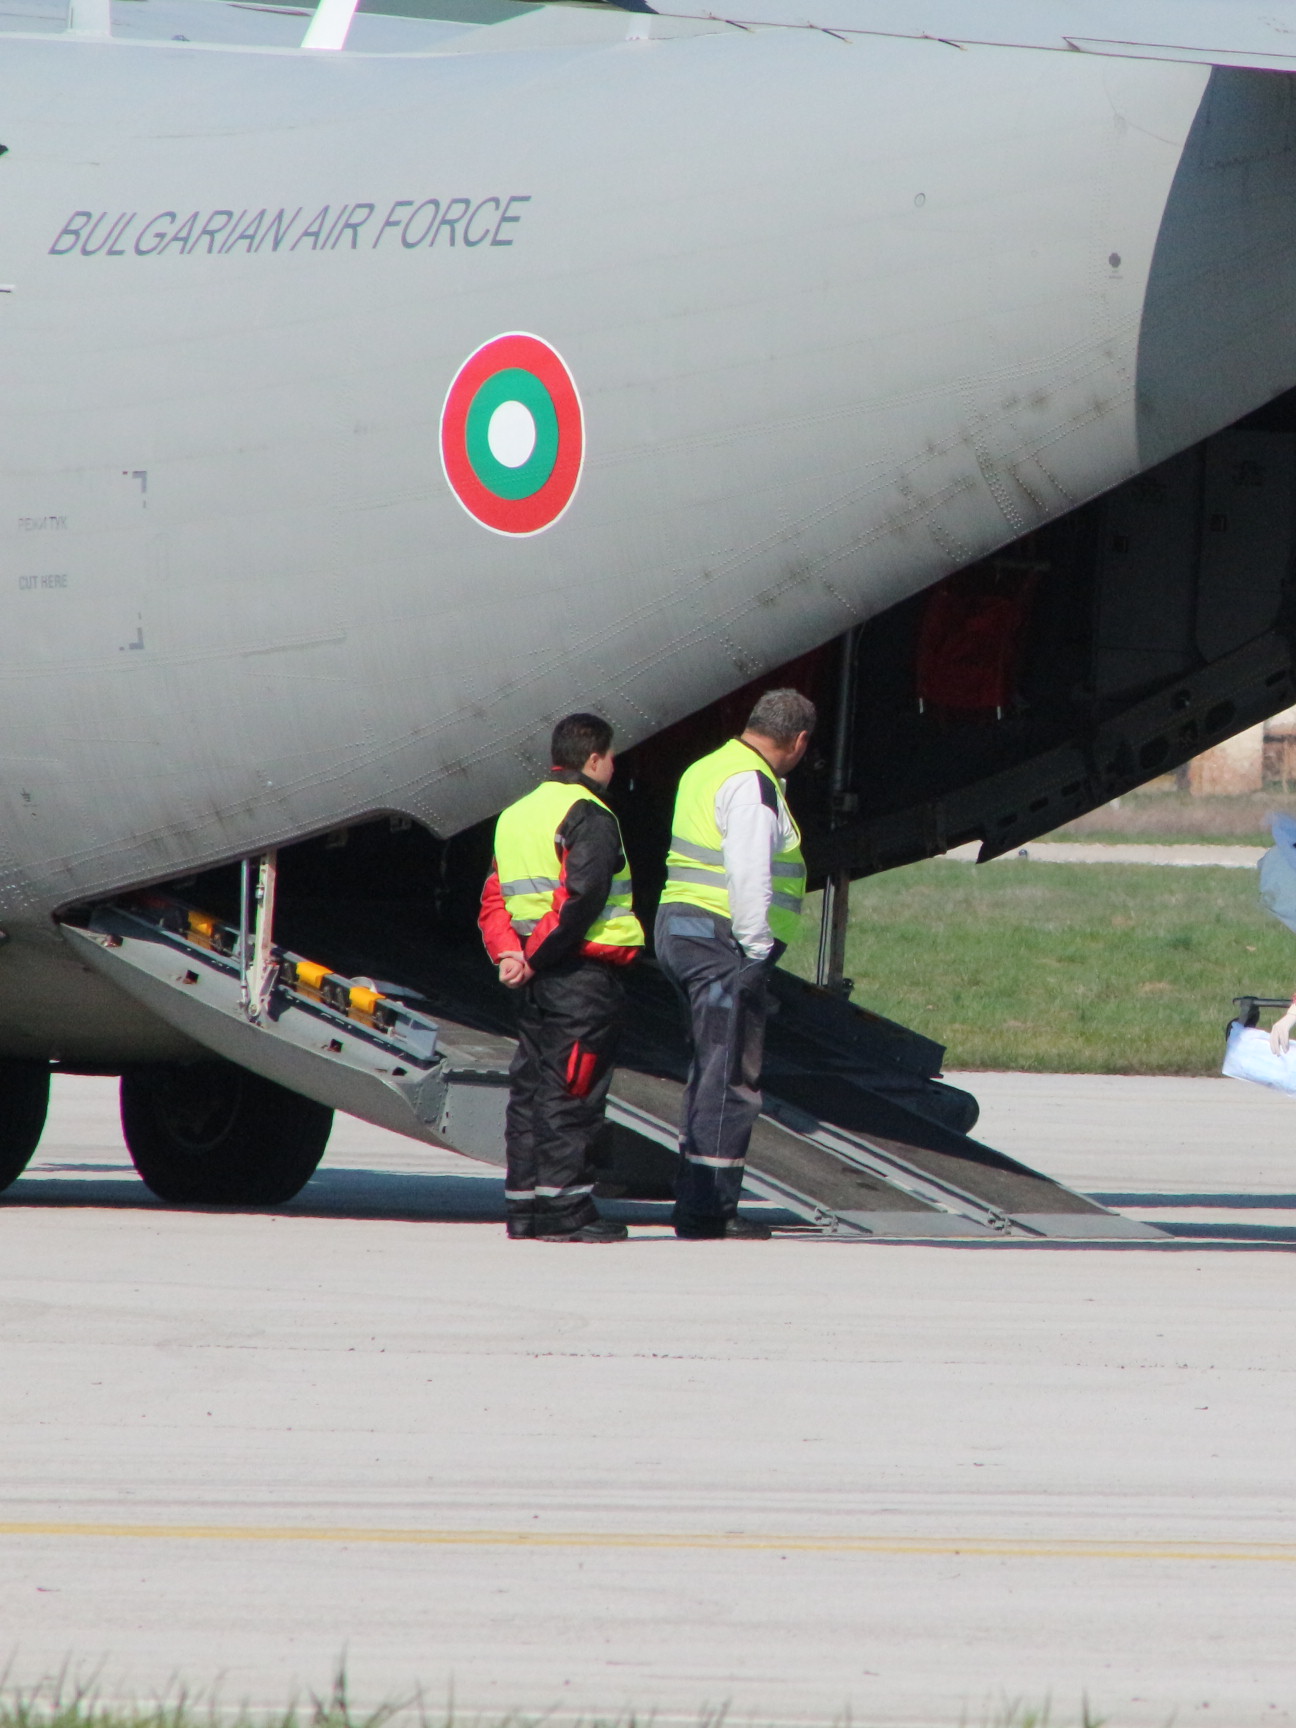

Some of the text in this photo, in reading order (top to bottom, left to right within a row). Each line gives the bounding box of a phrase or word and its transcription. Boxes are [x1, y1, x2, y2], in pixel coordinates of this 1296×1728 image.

[47, 194, 533, 257] BULGARIAN AIR FORCE
[18, 573, 68, 590] CUT HERE
